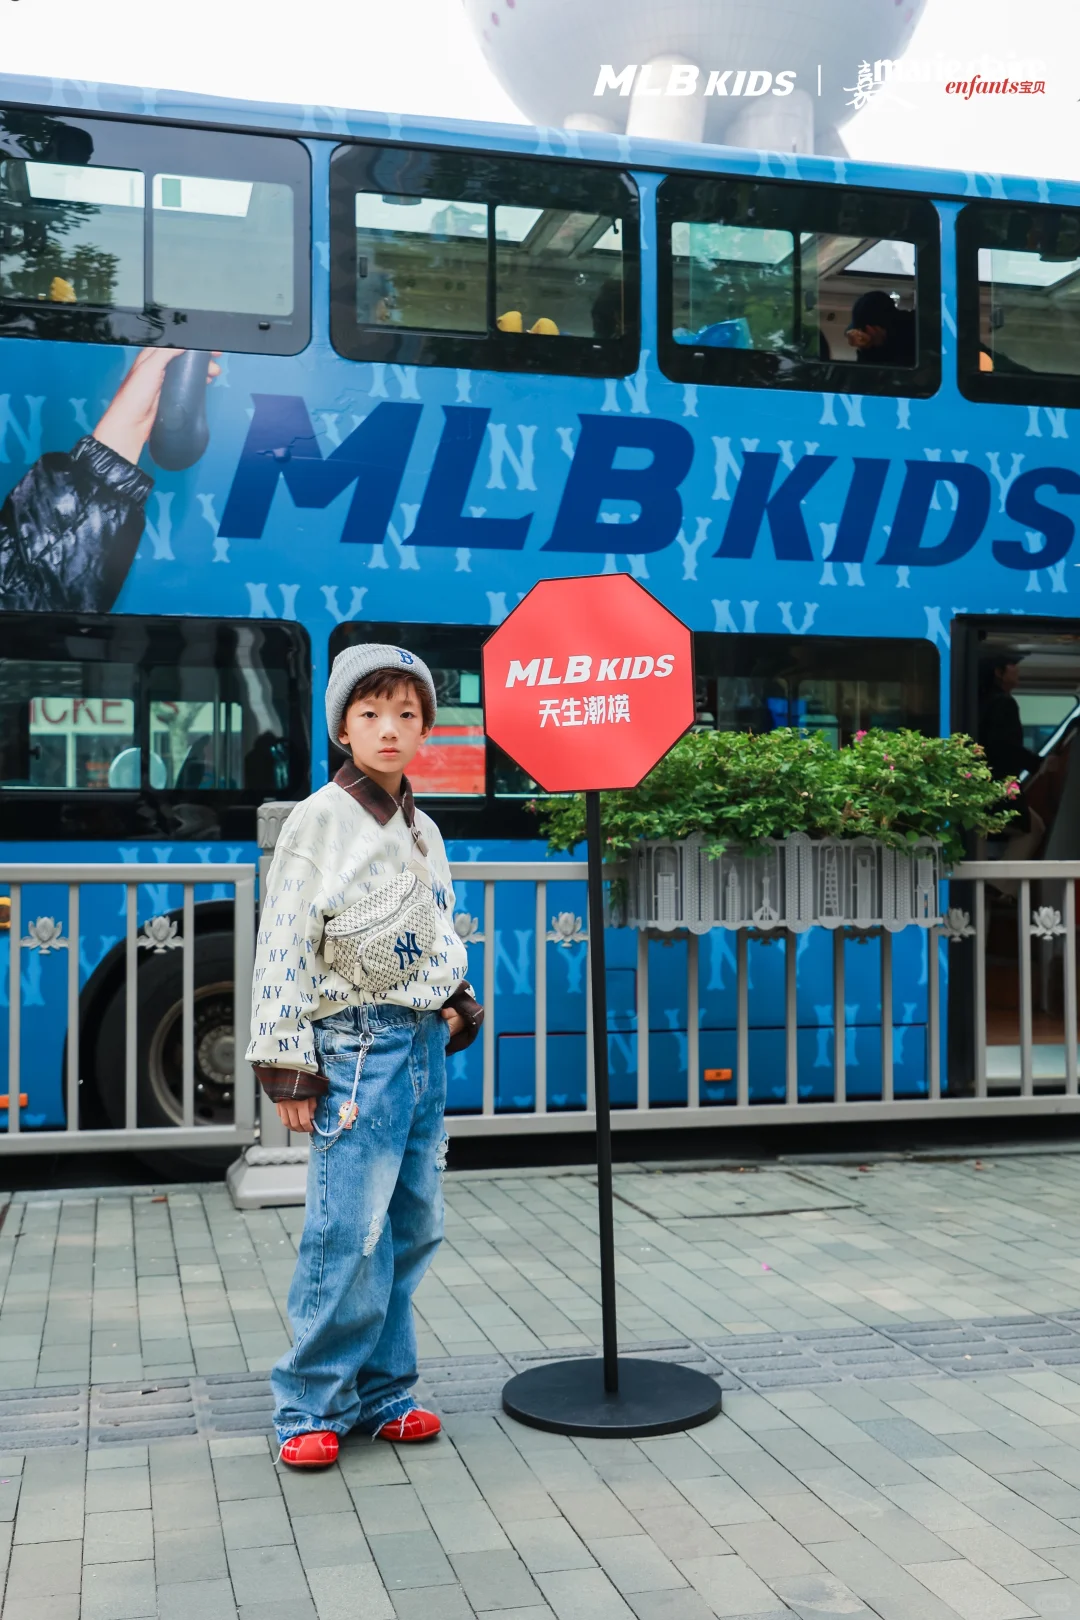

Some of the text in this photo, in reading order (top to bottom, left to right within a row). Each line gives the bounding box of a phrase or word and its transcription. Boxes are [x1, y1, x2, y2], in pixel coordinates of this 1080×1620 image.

[217, 393, 695, 555] MLB
[711, 451, 1080, 570] KIDS
[395, 649, 414, 665] B
[505, 654, 675, 688] MLB KIDS
[538, 693, 631, 728] 天生潮模
[394, 931, 423, 970] NY
